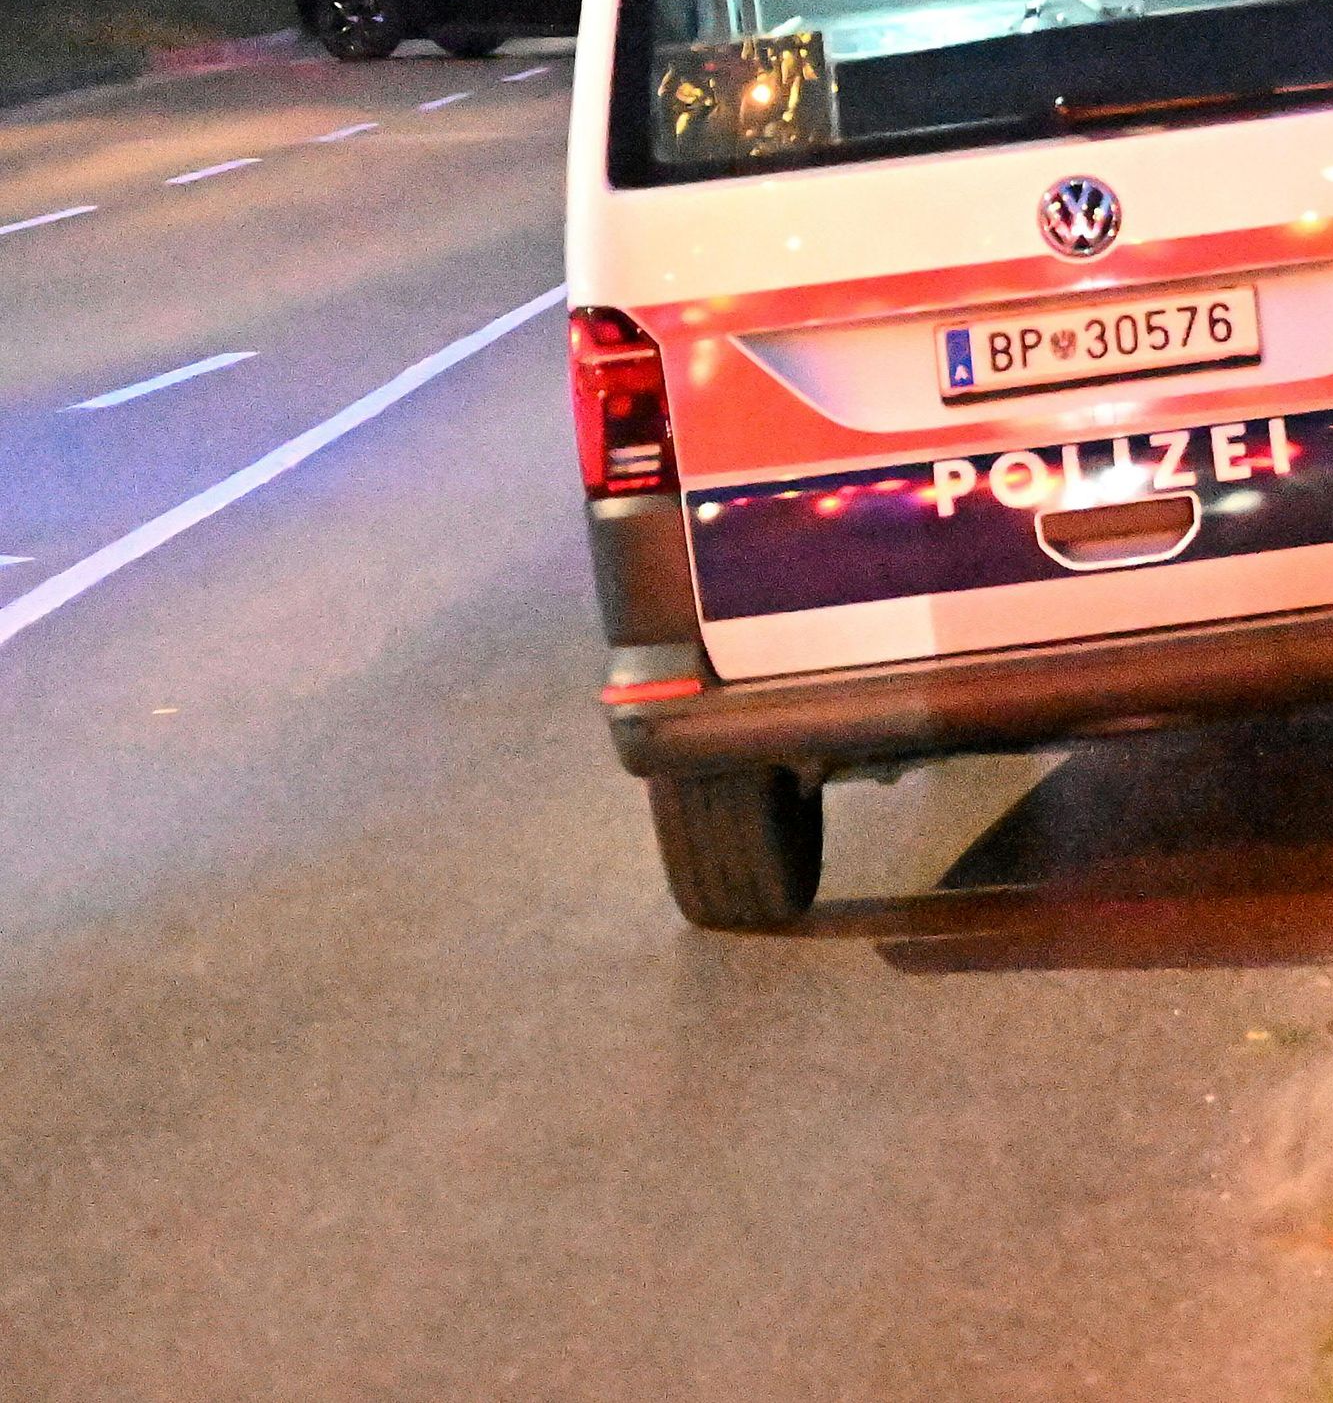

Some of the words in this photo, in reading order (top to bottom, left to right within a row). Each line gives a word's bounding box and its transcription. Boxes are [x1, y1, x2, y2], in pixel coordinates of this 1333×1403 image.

[988, 328, 1042, 373] BP
[1084, 302, 1233, 359] 30576
[932, 416, 1291, 517] POLIZEI
